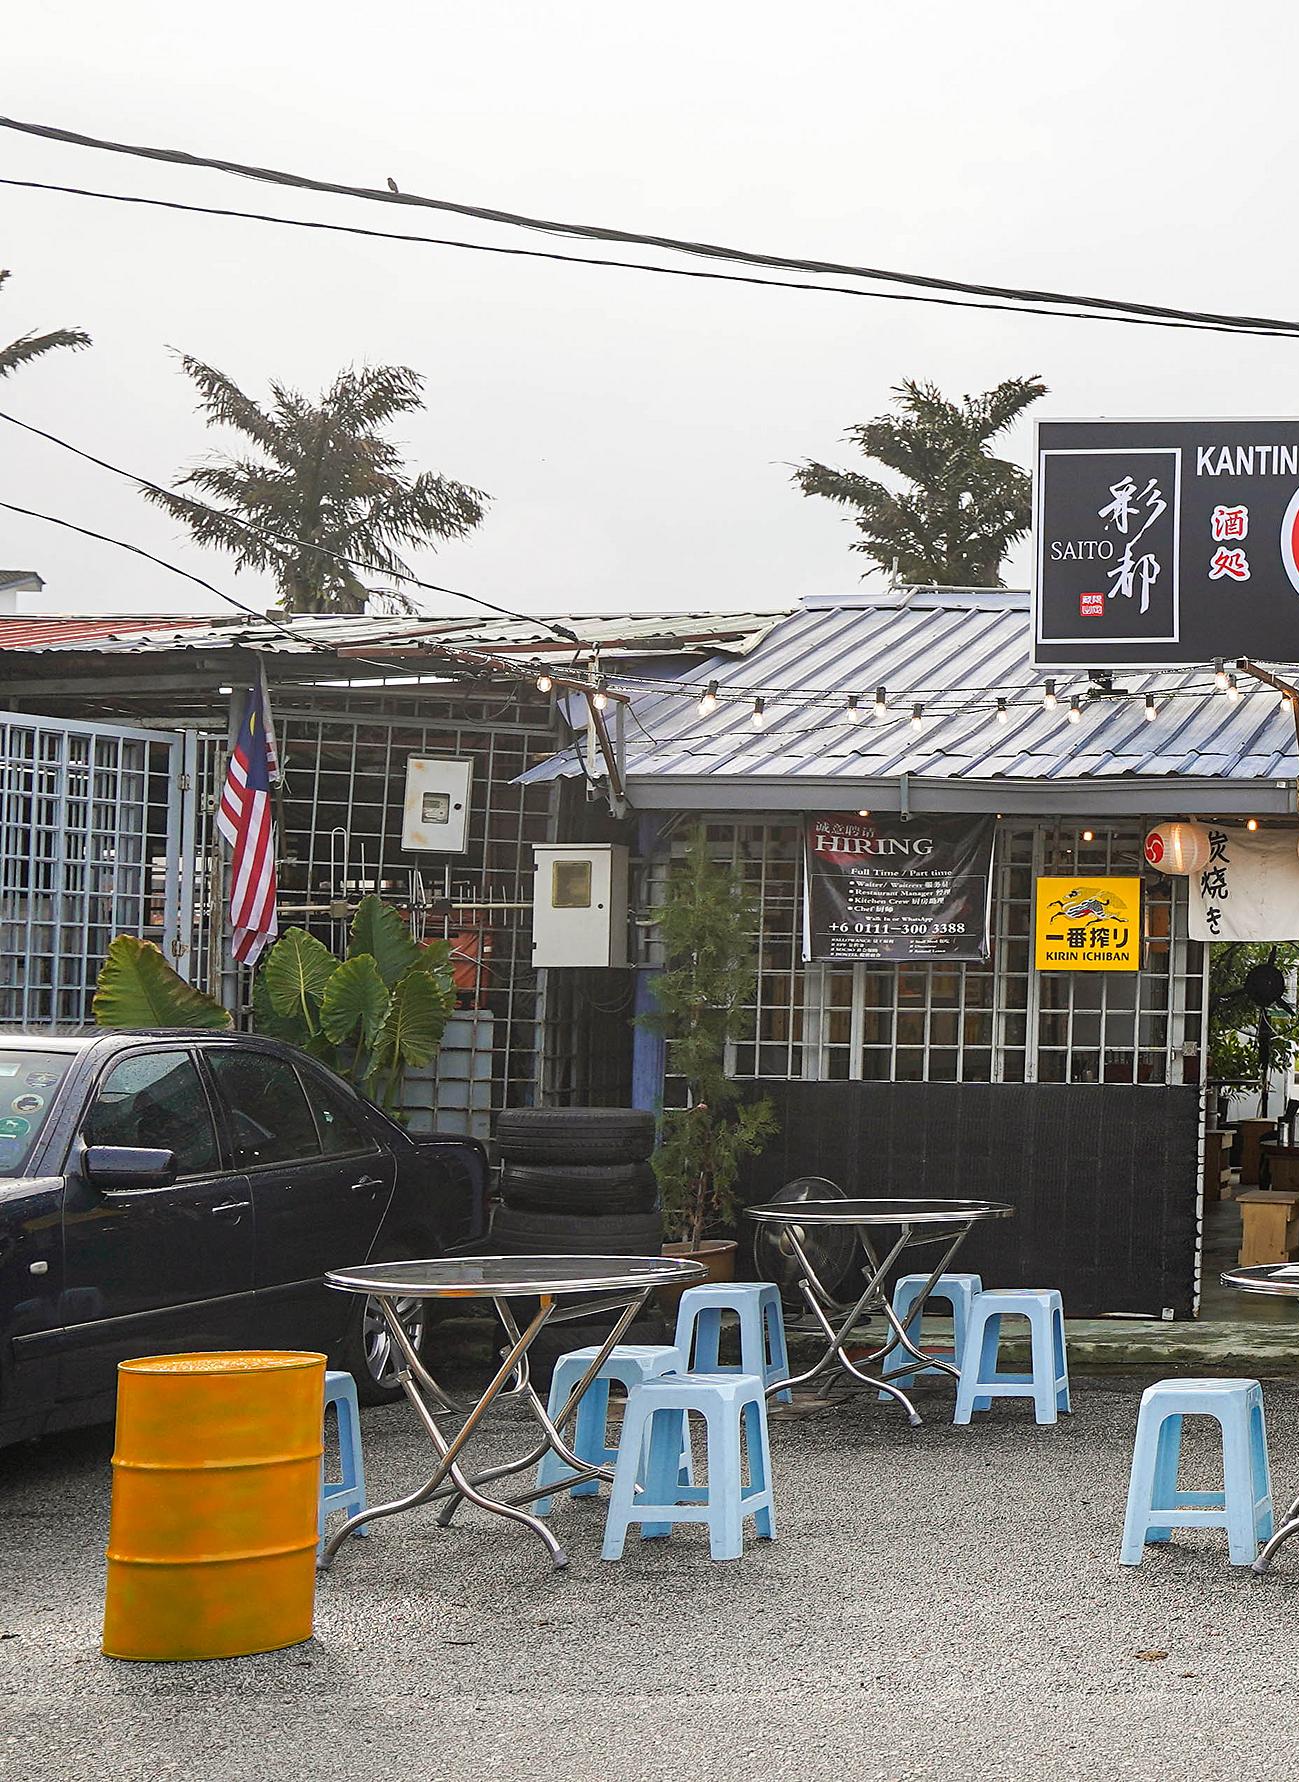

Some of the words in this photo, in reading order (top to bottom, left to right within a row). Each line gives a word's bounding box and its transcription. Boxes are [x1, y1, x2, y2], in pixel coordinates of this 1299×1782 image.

[1196, 446, 1298, 476] KANTIN
[1050, 540, 1114, 560] SAITO
[1209, 506, 1250, 581] 酒処
[815, 835, 934, 855] HIRING
[851, 868, 870, 876] Full
[873, 869, 899, 877] Time
[931, 869, 953, 877] time
[829, 922, 849, 933] +6
[931, 922, 966, 934] 3388
[1045, 927, 1129, 949] 一番搾り
[1046, 951, 1078, 961] KIRIN
[1083, 951, 1130, 961] ICHIBAN
